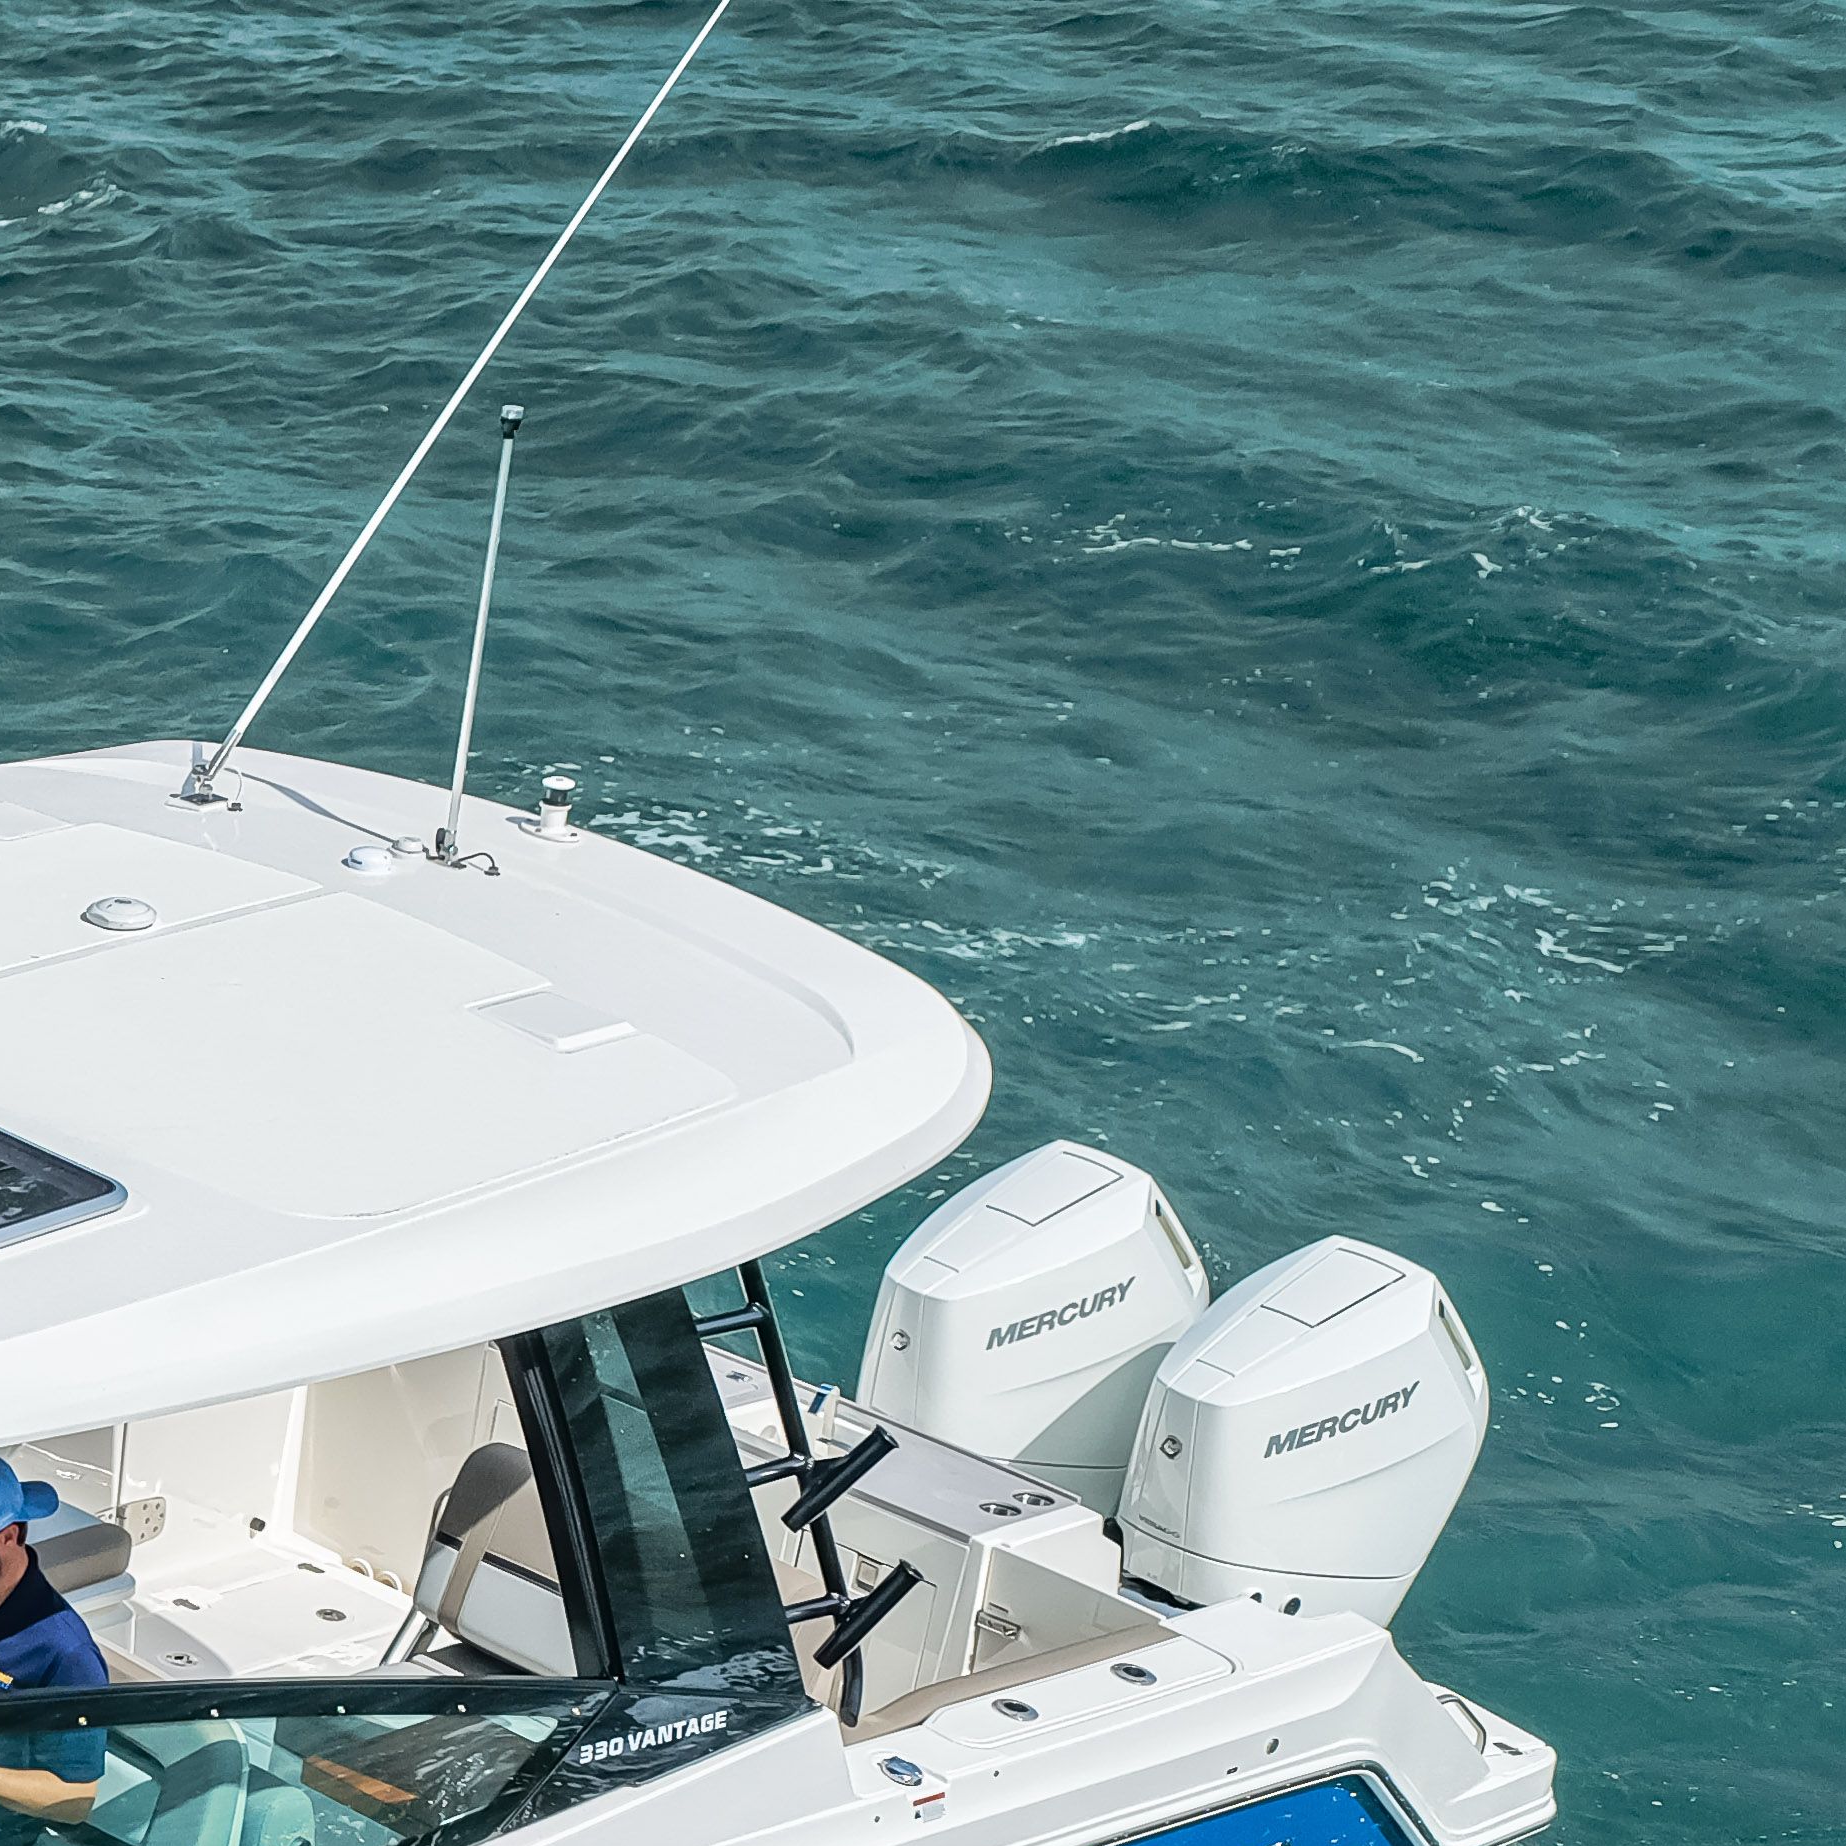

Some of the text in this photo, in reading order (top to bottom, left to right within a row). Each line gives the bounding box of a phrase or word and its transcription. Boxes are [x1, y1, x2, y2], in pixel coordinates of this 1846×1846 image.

[986, 1276, 1136, 1351] MERCURY
[1263, 1380, 1420, 1459] MERCURY
[579, 1710, 728, 1765] 330 VANTAGE
